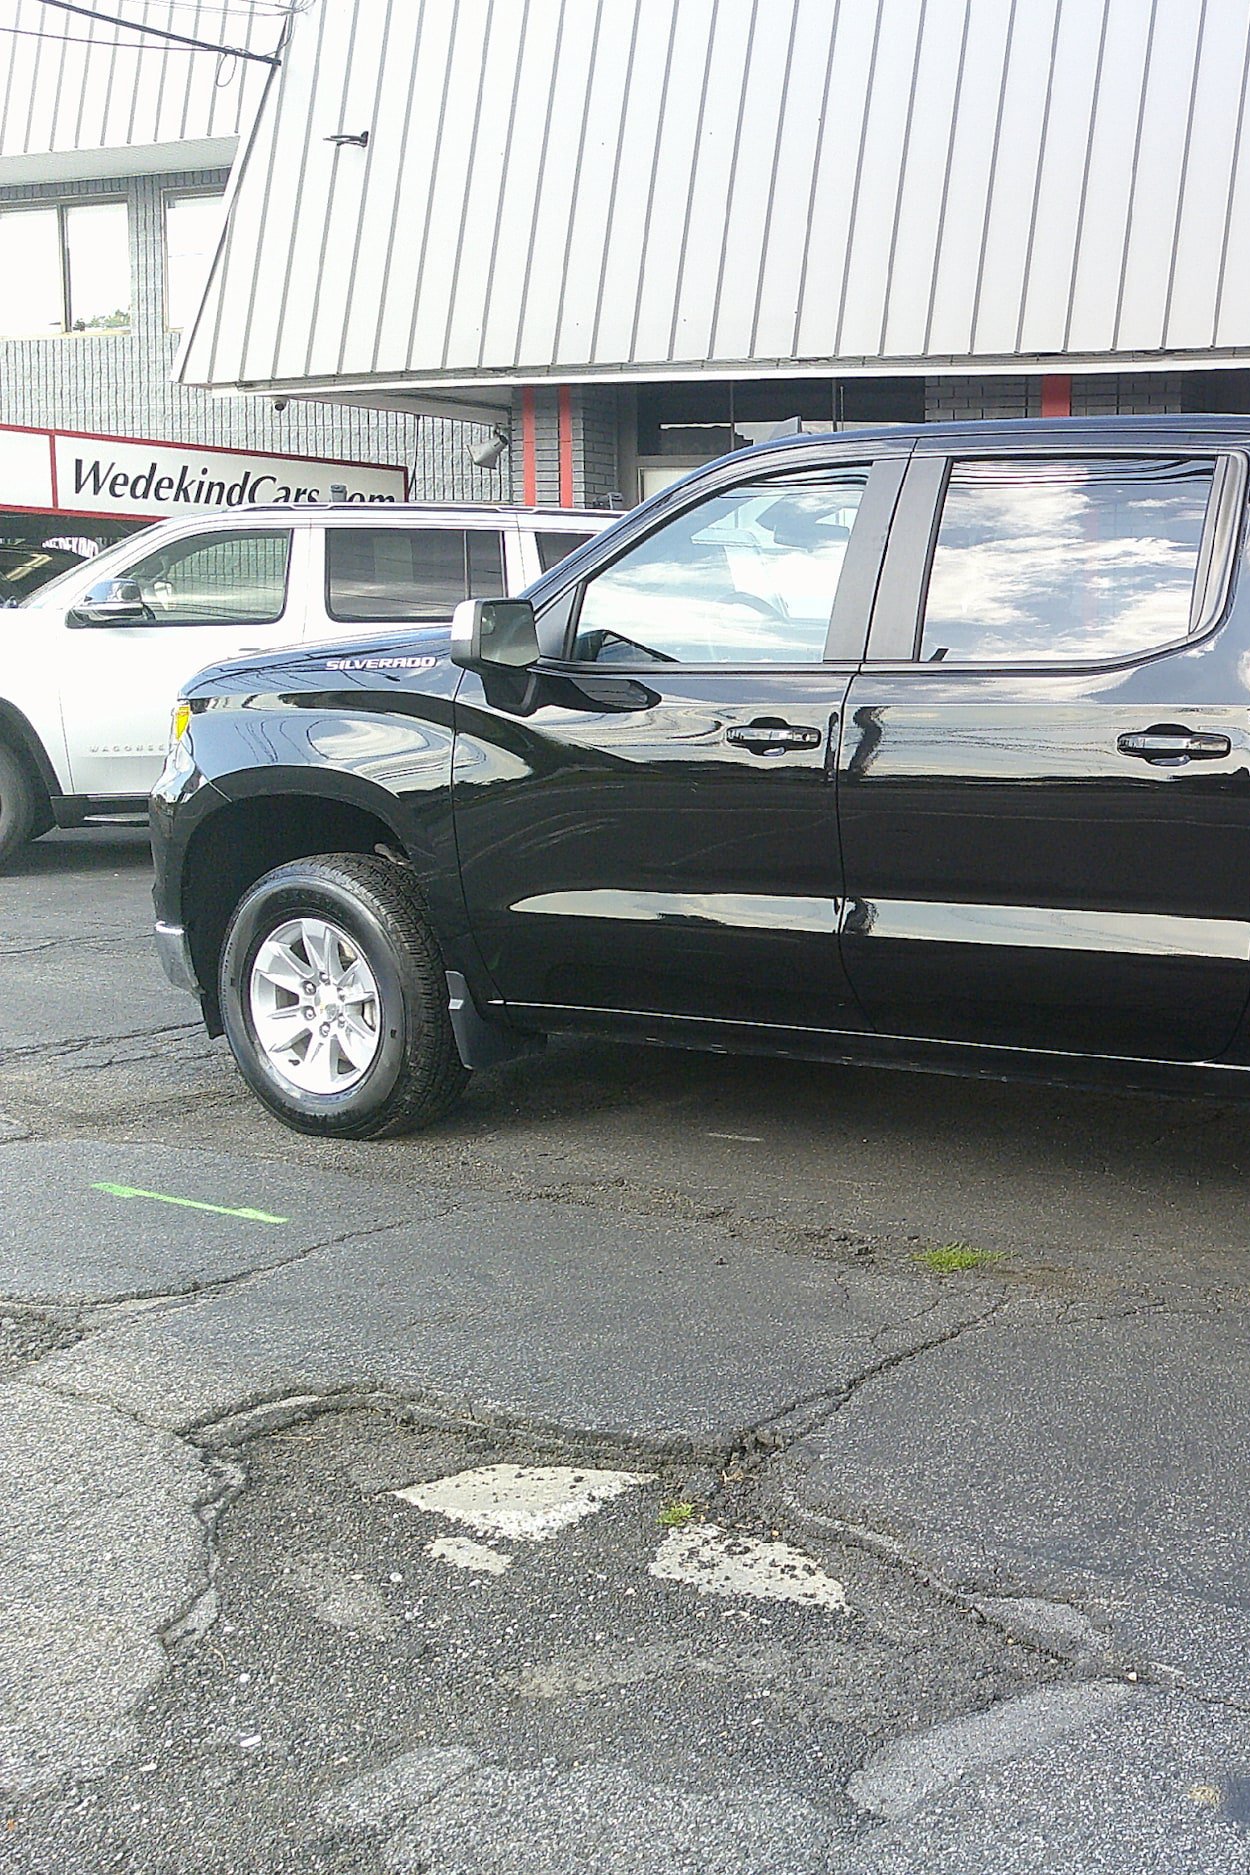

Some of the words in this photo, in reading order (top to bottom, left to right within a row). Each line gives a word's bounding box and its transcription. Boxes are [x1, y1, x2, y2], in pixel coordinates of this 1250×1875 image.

[73, 457, 394, 506] WedekindCarso
[325, 656, 437, 671] SILVERADO
[89, 744, 166, 753] WAGONEE
